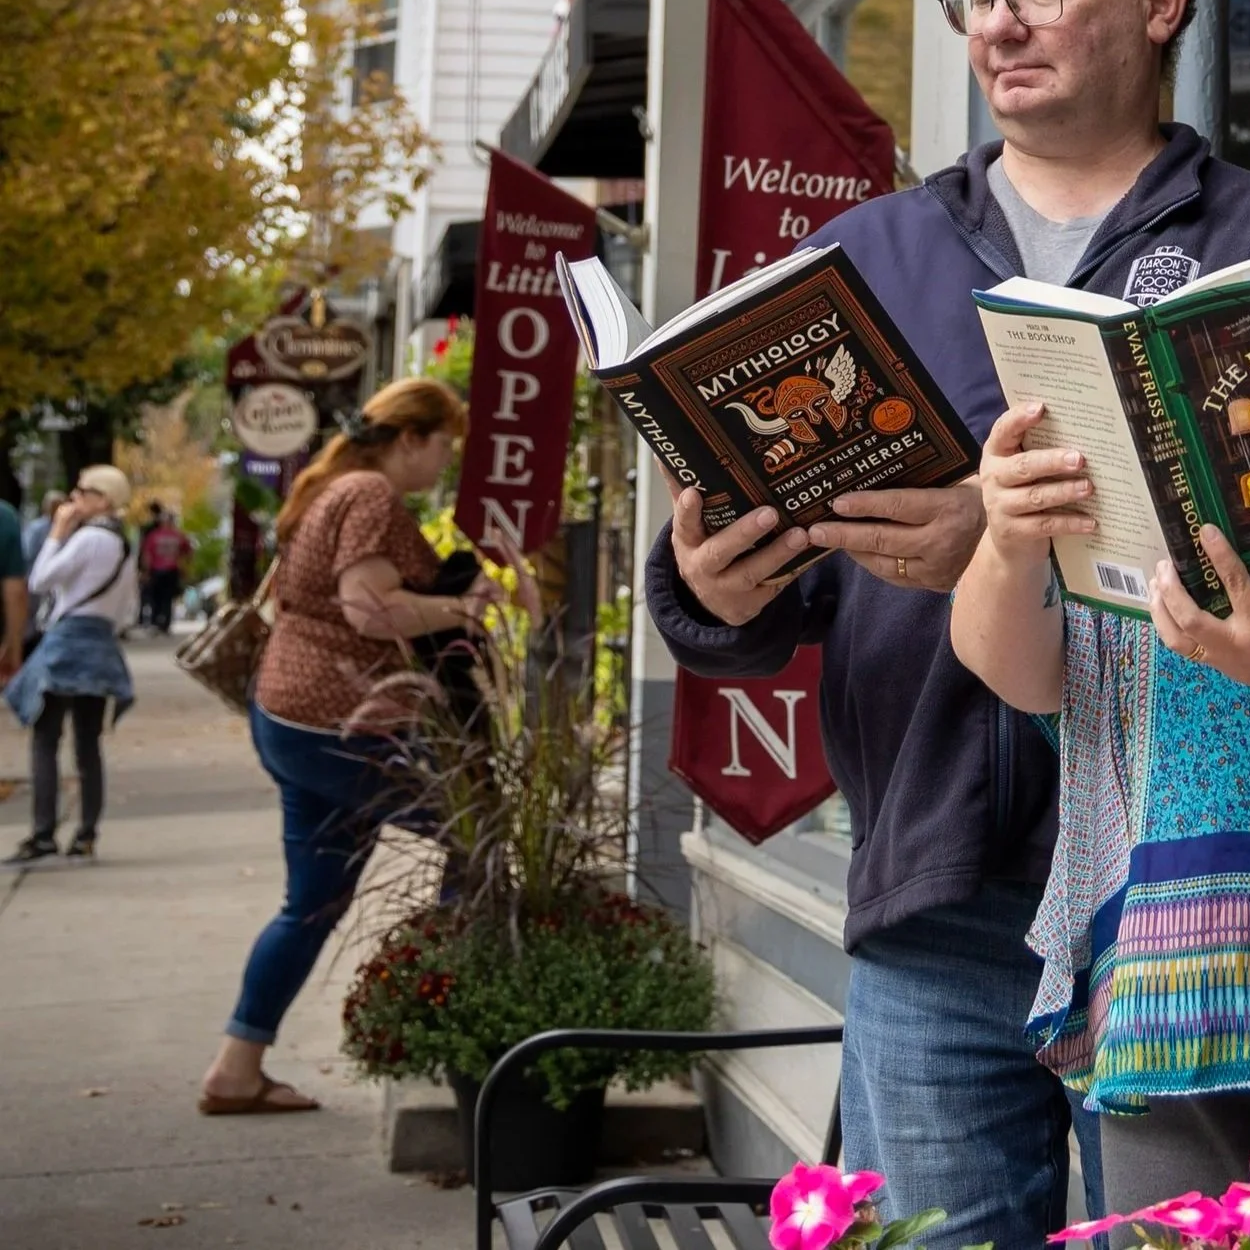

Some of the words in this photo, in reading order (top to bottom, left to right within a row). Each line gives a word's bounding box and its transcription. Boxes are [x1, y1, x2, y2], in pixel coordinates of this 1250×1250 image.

[722, 156, 871, 202] Welcome
[497, 212, 584, 239] Welcome
[778, 207, 810, 239] to
[1134, 276, 1182, 290] BOOKS
[1139, 257, 1189, 273] AARON'S
[697, 312, 842, 403] MYTHOLOGY
[1007, 330, 1026, 341] THE
[1028, 332, 1077, 346] BOOKSHOP
[1123, 320, 1149, 367] EVAN
[1139, 369, 1165, 419] FRISS
[1202, 363, 1248, 411] THE
[619, 391, 708, 492] MYTHOLOGY
[775, 463, 827, 495] TIMELESS
[830, 444, 862, 465] TALES
[864, 434, 879, 446] OF
[785, 479, 834, 511] GODS
[836, 469, 854, 482] AND
[855, 430, 924, 473] HEROES
[856, 462, 904, 491] HAMILTON
[1169, 461, 1190, 498] THE
